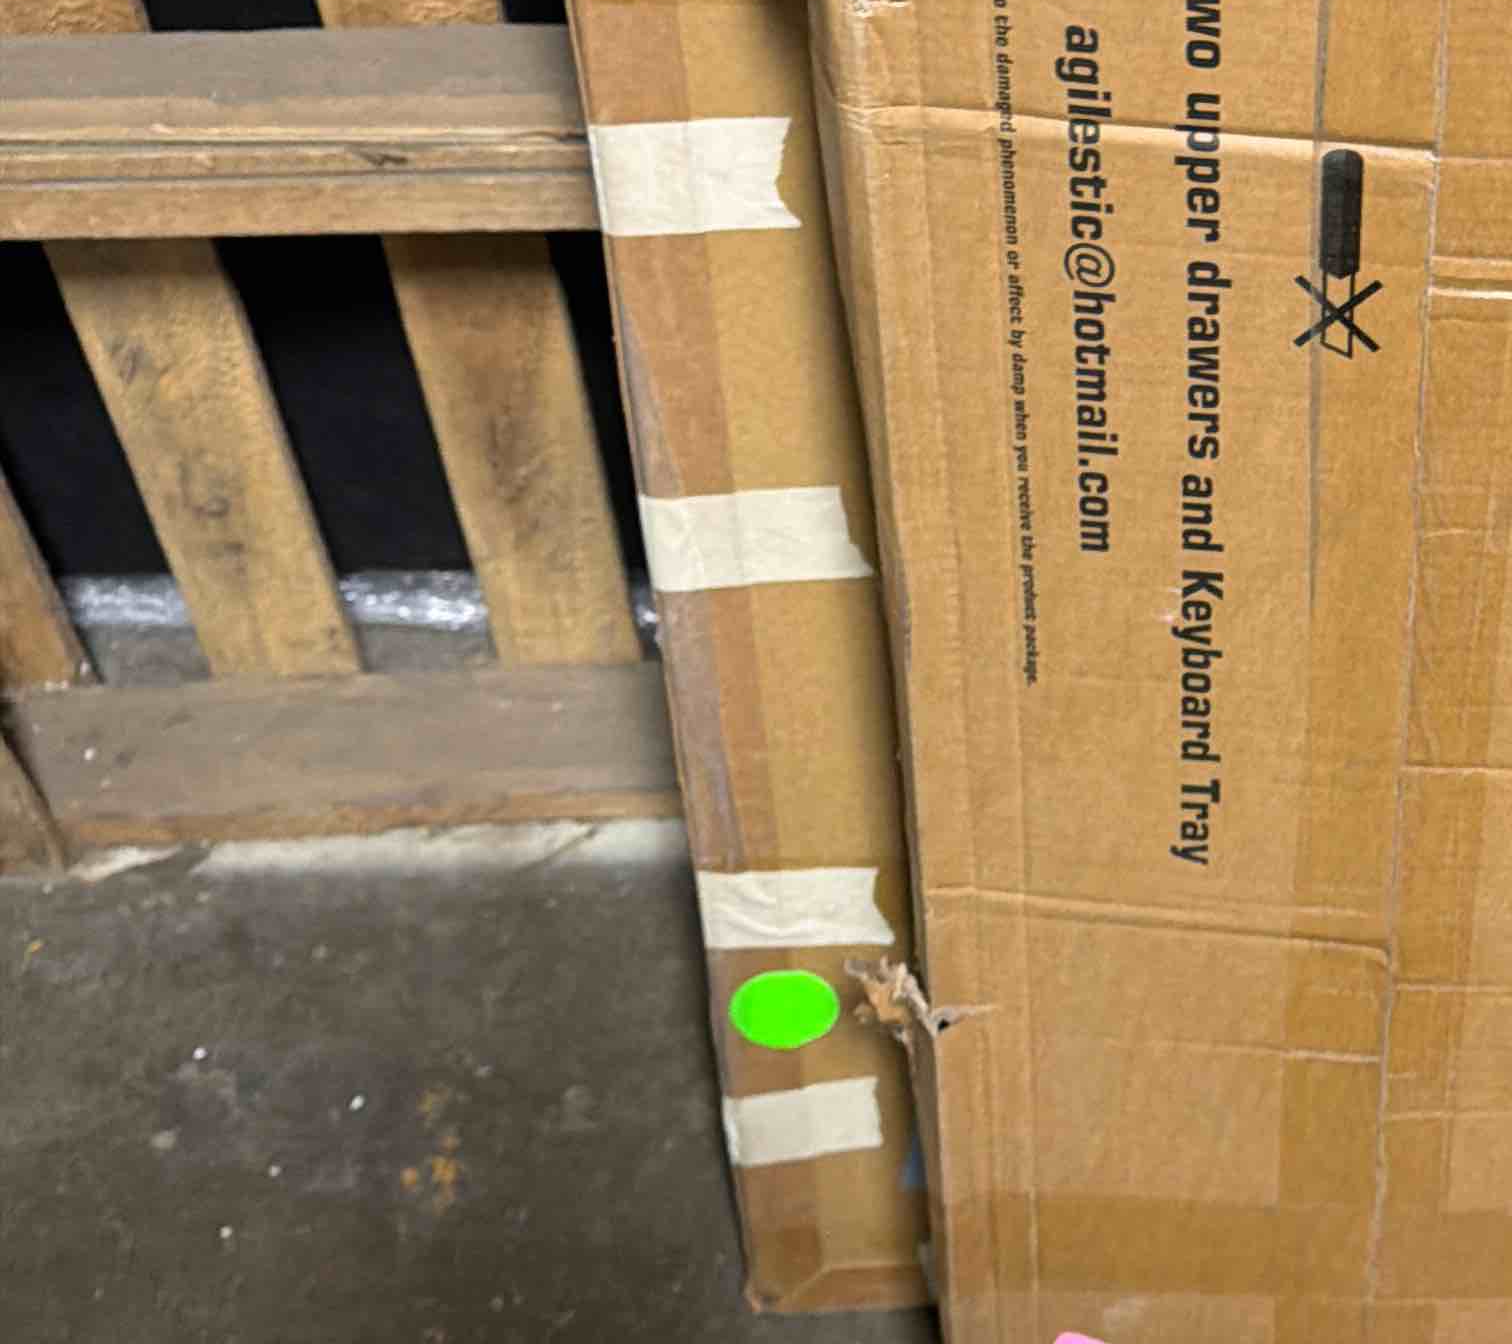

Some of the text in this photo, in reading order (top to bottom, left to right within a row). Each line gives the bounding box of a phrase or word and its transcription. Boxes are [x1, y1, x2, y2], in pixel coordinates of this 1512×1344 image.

[992, 15, 1013, 46] the
[996, 53, 1017, 133] damaged
[995, 138, 1019, 244] phenomenon
[1174, 93, 1221, 242] upper
[1003, 250, 1019, 269] or
[999, 274, 1026, 323] affect
[1055, 25, 1118, 552] agilestic@hotmail.com
[1005, 329, 1027, 348] by
[1186, 260, 1232, 459] drawers
[1009, 352, 1029, 394] damp
[1013, 400, 1031, 440] when
[1011, 444, 1030, 471] you
[1017, 476, 1035, 530] receive
[1181, 474, 1224, 552] and
[1020, 535, 1037, 561] the
[1017, 564, 1039, 620] product
[1171, 570, 1224, 763] Keyboard
[1170, 779, 1221, 865] Tray
